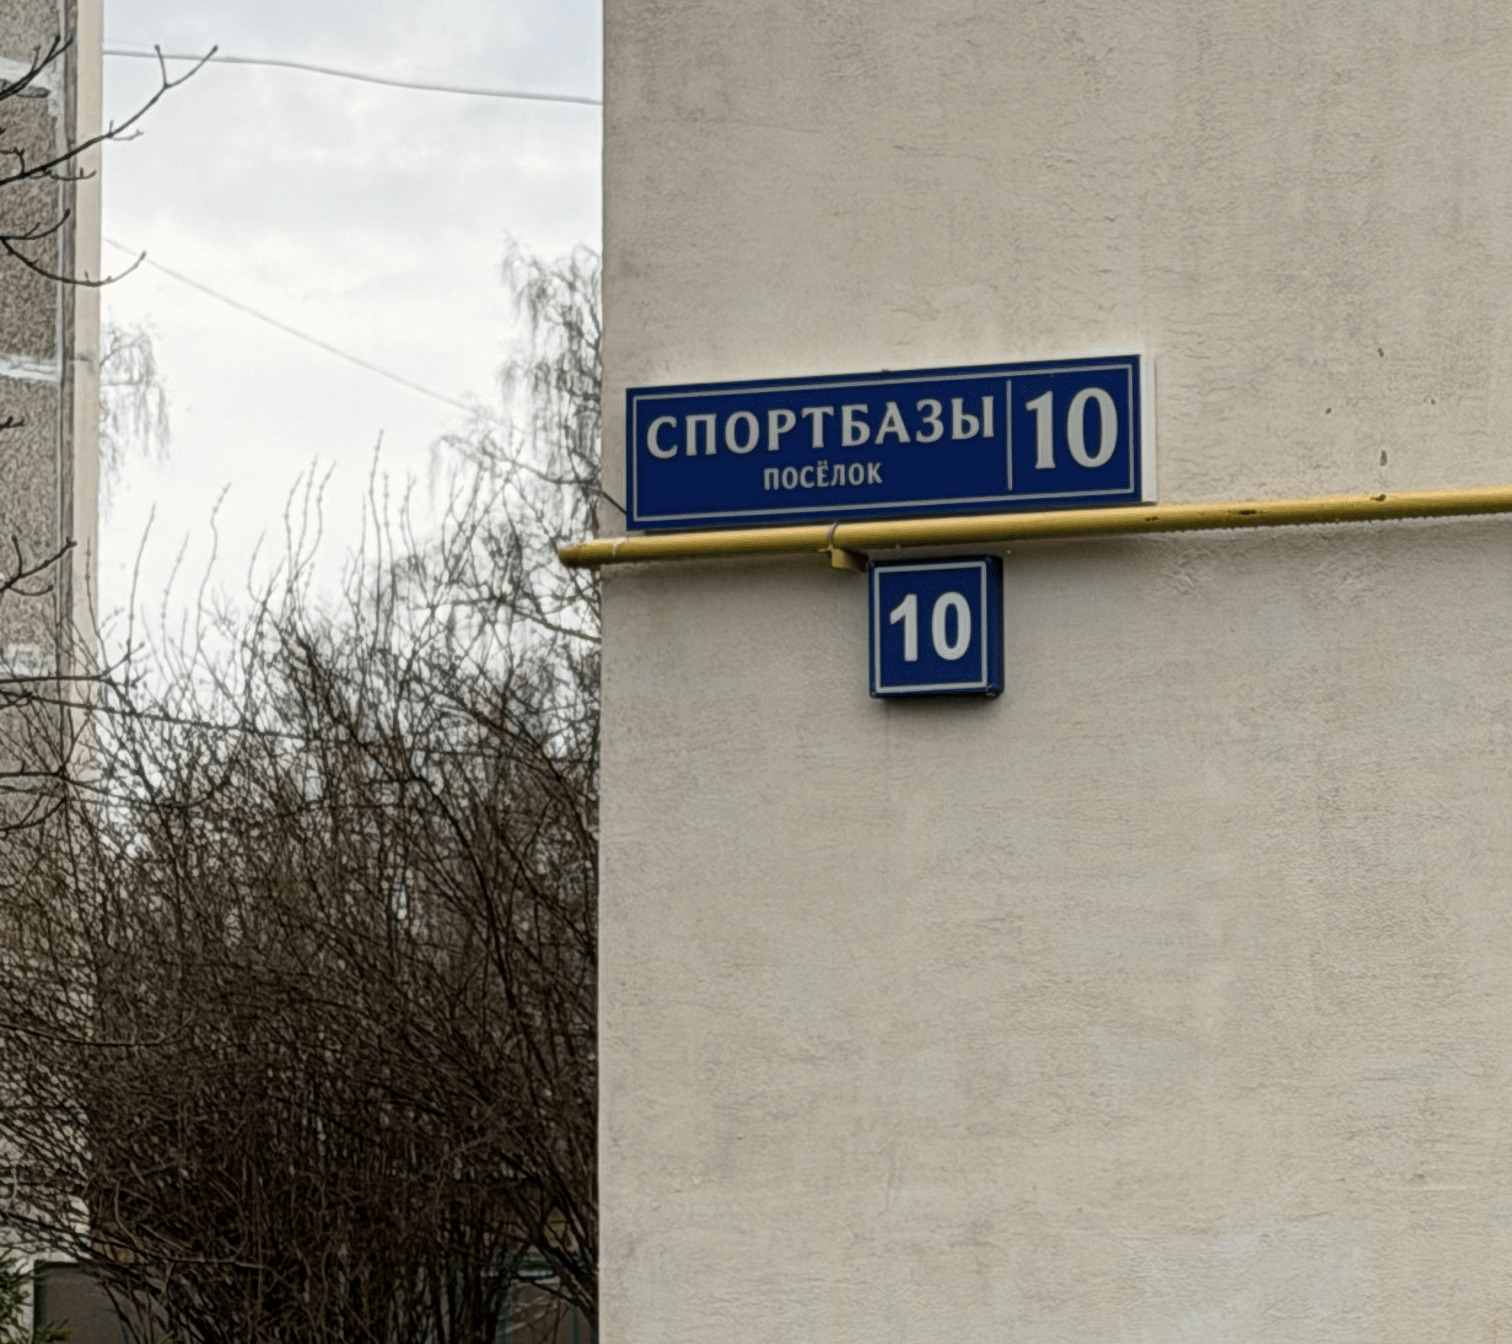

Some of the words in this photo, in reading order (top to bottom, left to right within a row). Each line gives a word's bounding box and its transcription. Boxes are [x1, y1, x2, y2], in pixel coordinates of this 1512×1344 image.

[646, 395, 995, 459] СПОРТБАЗЫ
[1025, 387, 1118, 470] 10
[763, 459, 883, 491] ПОСЁЛОК
[889, 591, 972, 662] 10
